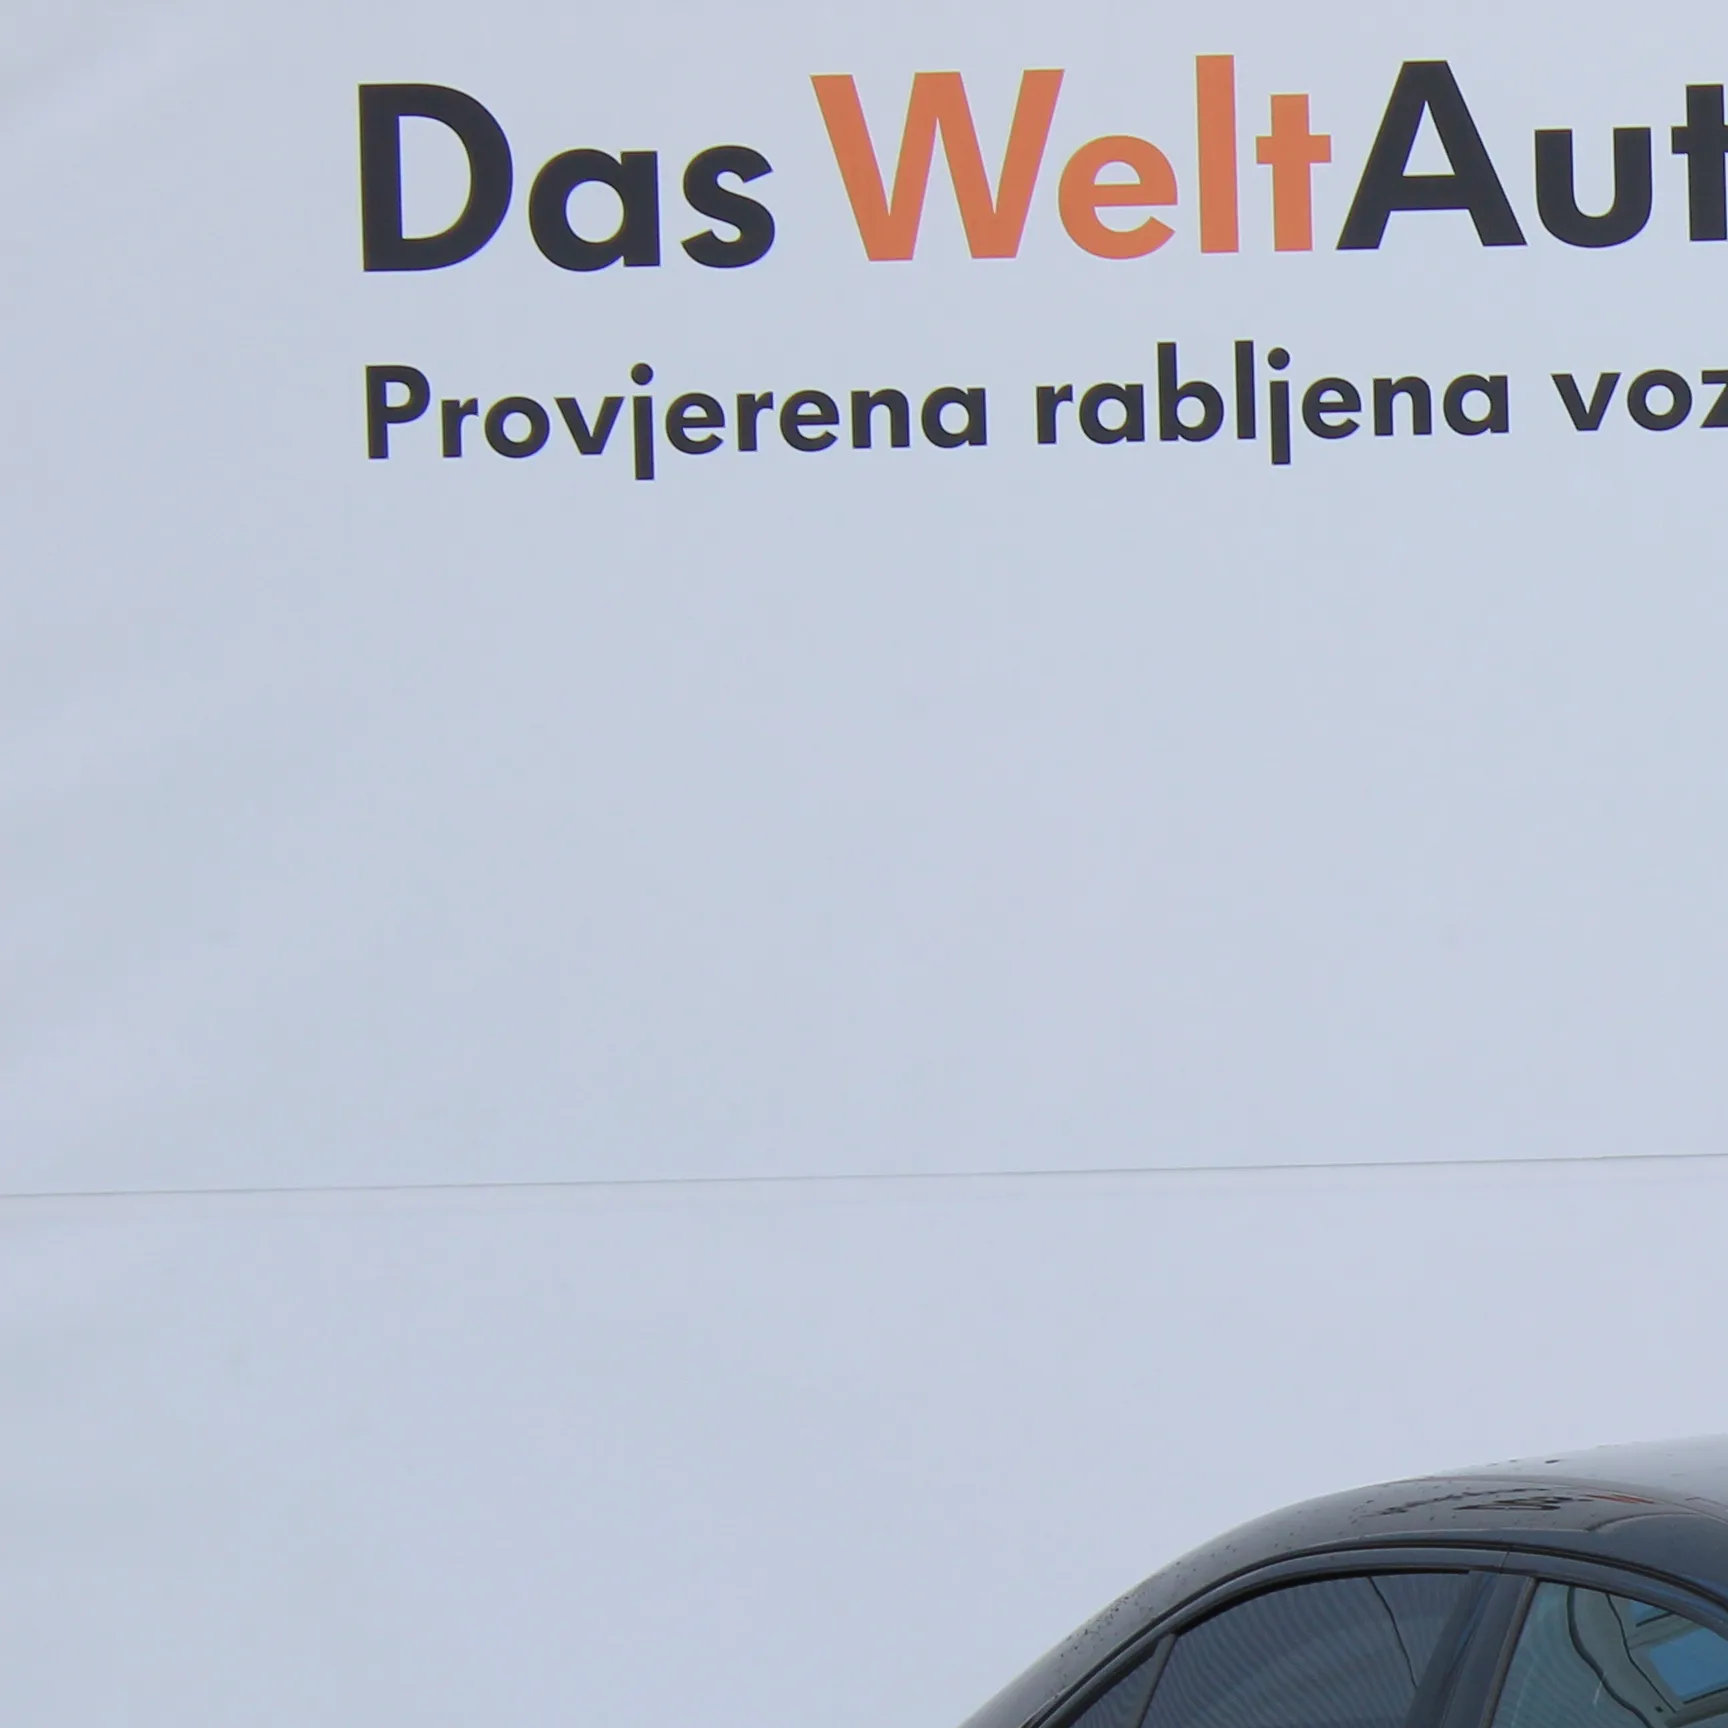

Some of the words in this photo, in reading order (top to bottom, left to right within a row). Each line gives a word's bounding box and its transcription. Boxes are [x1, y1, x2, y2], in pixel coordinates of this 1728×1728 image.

[358, 83, 776, 273] Das
[365, 362, 988, 481] Provjerena
[1035, 339, 1510, 466] rabljena
